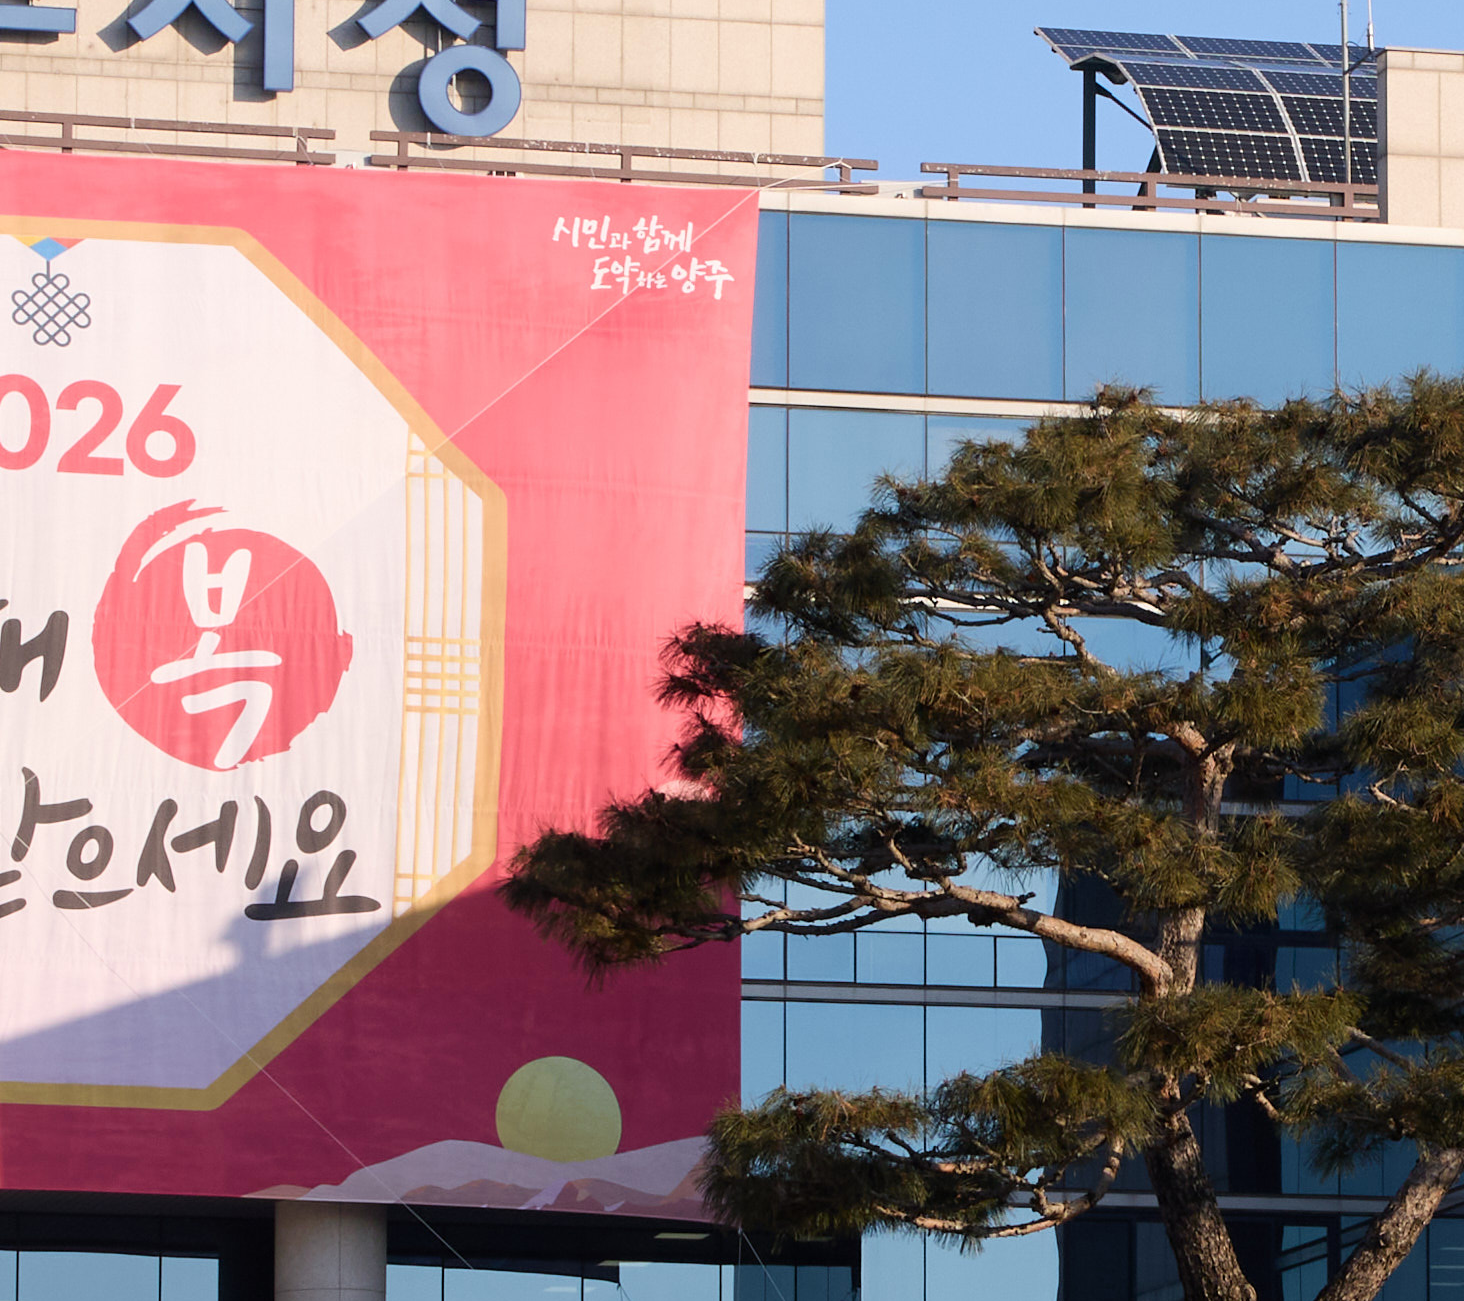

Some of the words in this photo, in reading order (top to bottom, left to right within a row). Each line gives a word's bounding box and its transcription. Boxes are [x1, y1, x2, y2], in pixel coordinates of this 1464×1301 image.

[552, 215, 632, 250] 시민과
[632, 215, 693, 254] 함께
[590, 255, 668, 295] 도약하는
[671, 257, 735, 300] 양주
[150, 541, 282, 770] 복
